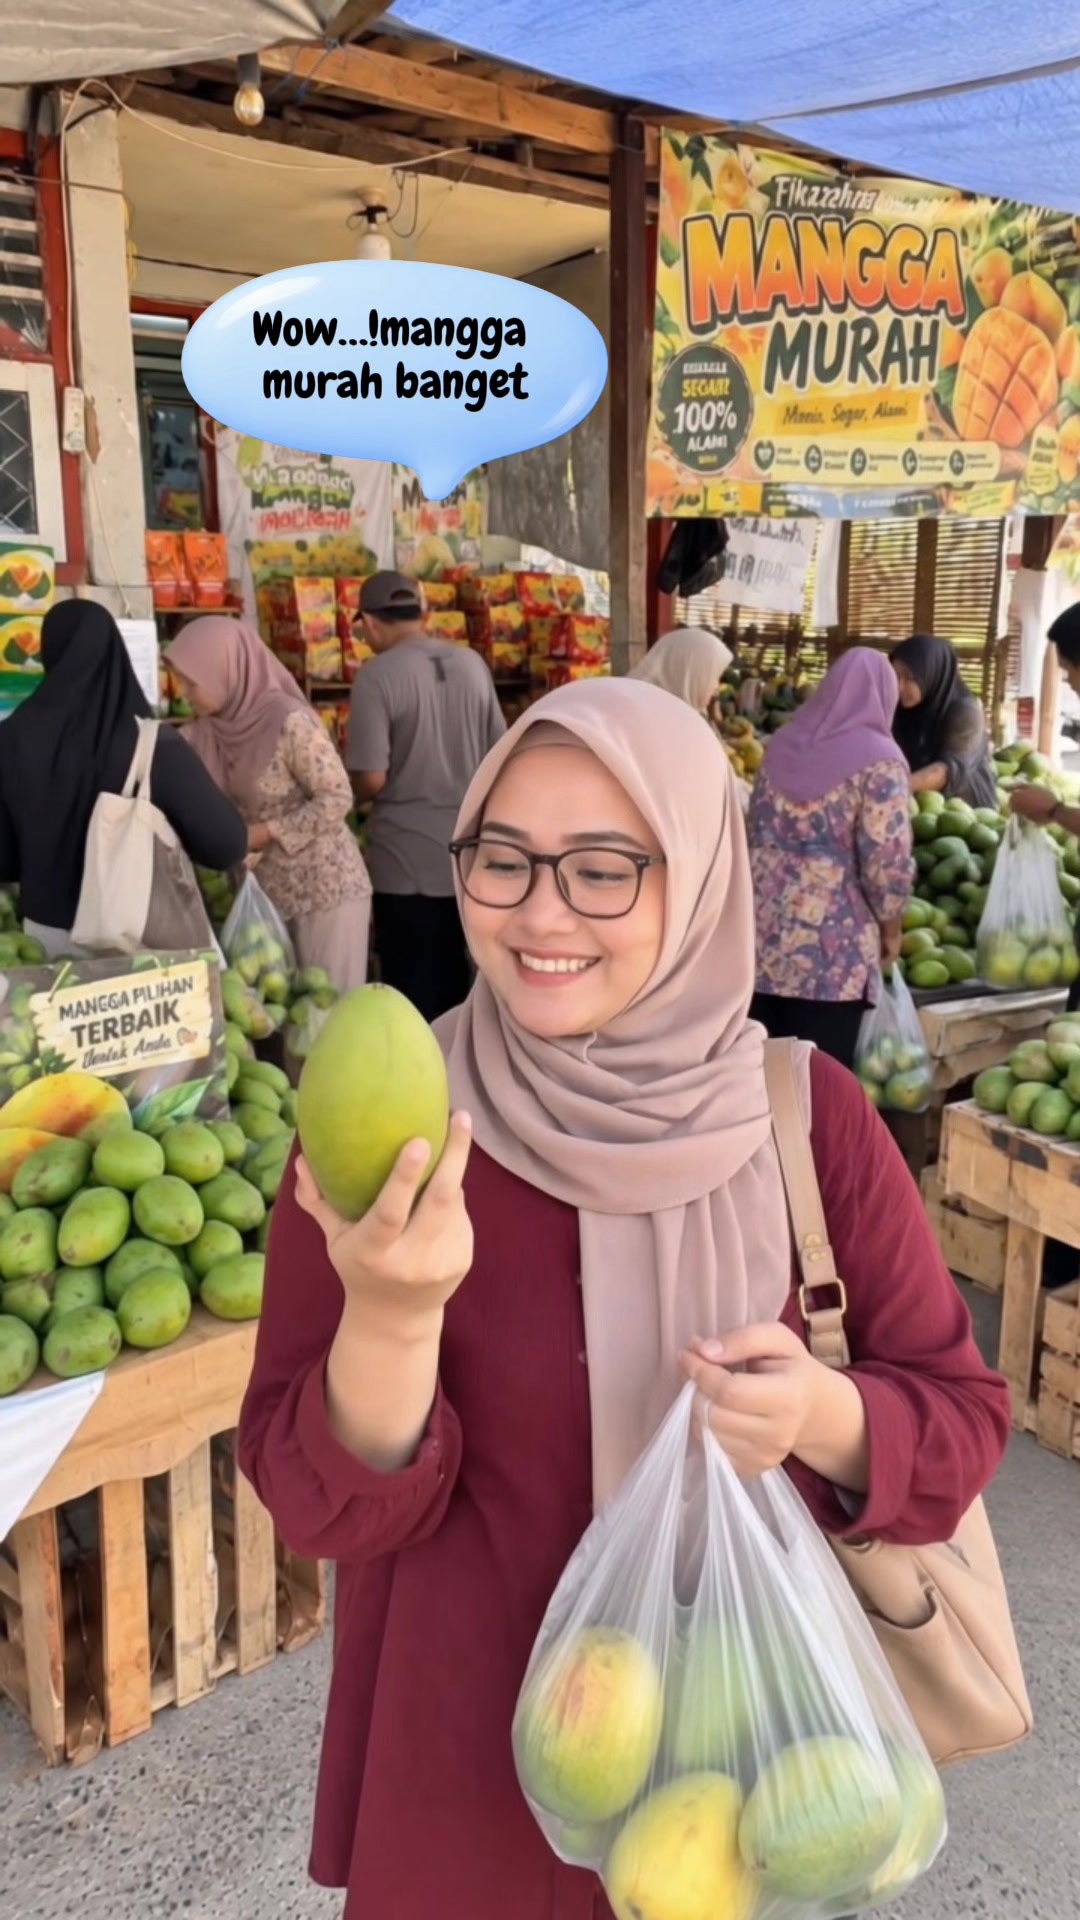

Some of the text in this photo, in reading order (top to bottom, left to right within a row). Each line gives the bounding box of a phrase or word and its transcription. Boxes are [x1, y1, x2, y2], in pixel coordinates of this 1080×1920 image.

[682, 213, 967, 336] MANGGA
[764, 317, 940, 394] MURAH
[672, 400, 737, 434] 100%
[132, 975, 194, 1005] PILIHAN
[70, 998, 181, 1049] TERBAIK
